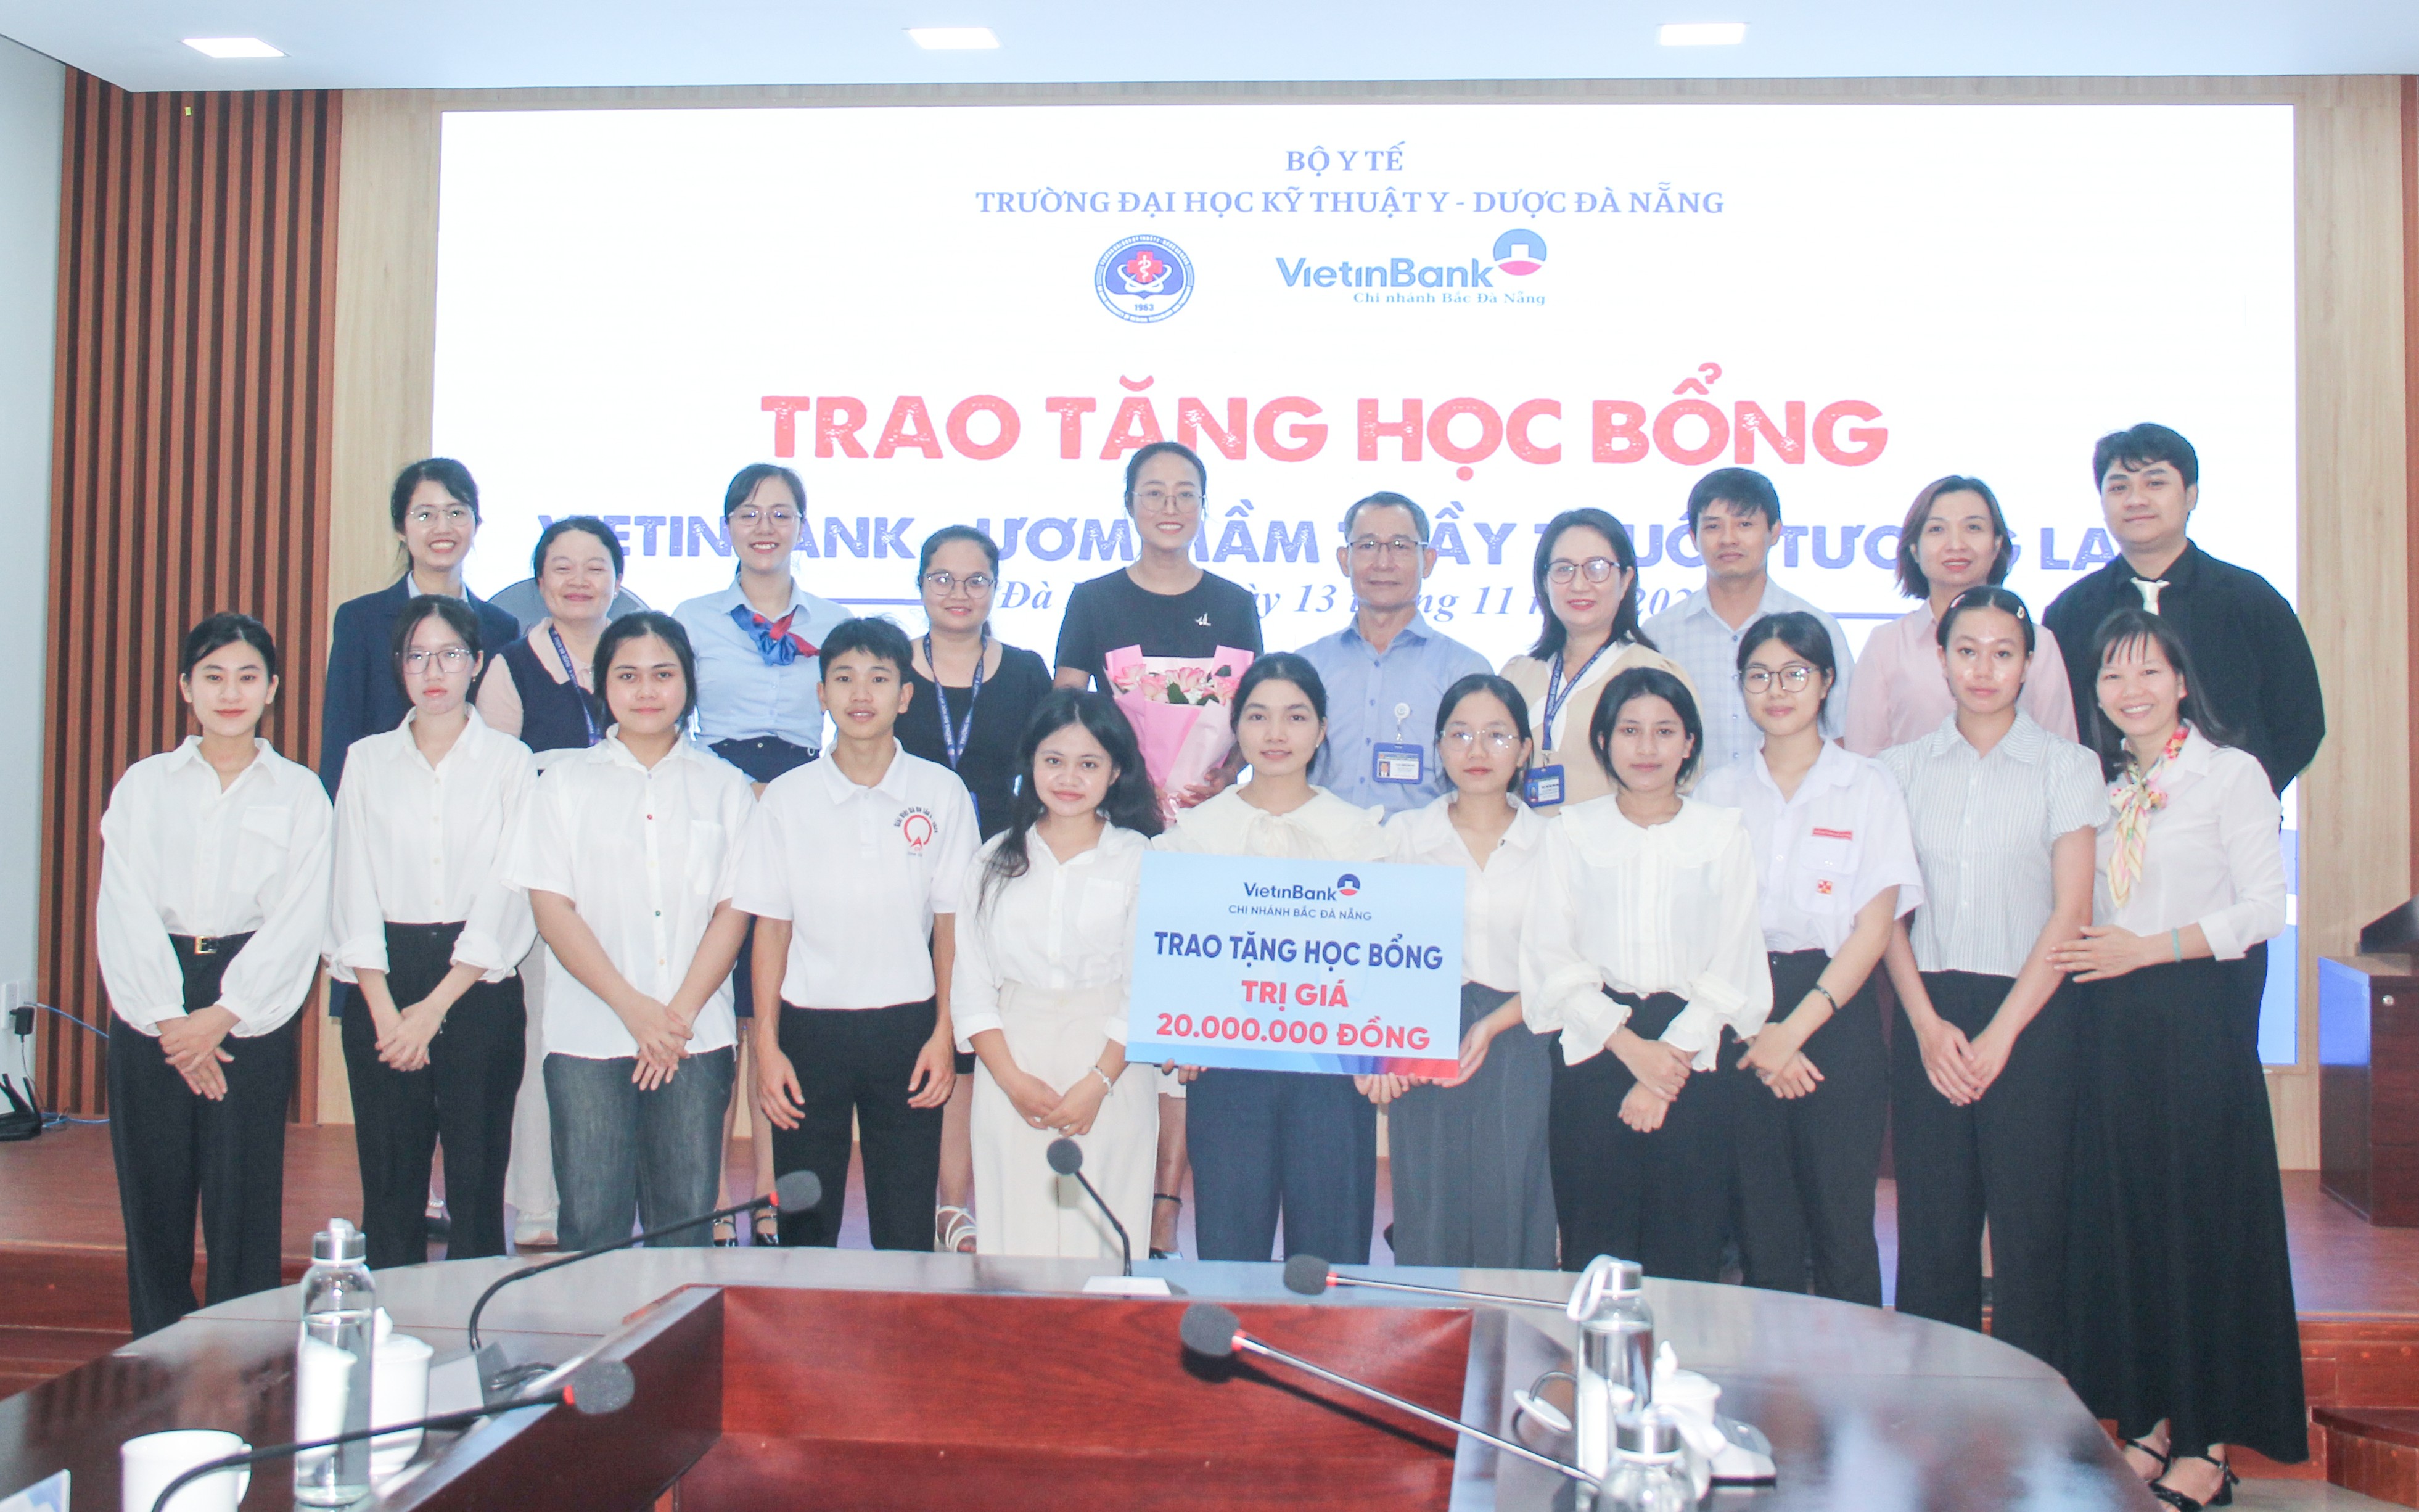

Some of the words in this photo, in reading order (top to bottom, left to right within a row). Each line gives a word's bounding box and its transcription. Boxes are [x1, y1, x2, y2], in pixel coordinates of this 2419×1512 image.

[1286, 144, 1330, 178] BỘ
[1337, 150, 1359, 171] Y
[1365, 141, 1406, 171] TẾ
[975, 186, 1110, 213] TRƯỜNG
[1118, 191, 1175, 218] ĐẠI
[1184, 191, 1254, 218] HỌC
[1262, 186, 1304, 213] KỸ
[1309, 186, 1423, 219] THUẬT
[1427, 191, 1450, 213] Y
[1472, 188, 1566, 219] DƯỢC
[1574, 186, 1622, 213] ĐÀ
[1628, 181, 1725, 214] NẴNG
[1275, 257, 1495, 288] VietinBank
[1134, 303, 1155, 311] 1963
[1353, 292, 1380, 303] Chi
[1386, 292, 1436, 303] nhánh
[1477, 292, 1498, 303] Đà
[761, 395, 1021, 461] TRAO
[1357, 396, 1562, 482] HỌC
[1591, 361, 1889, 467] BỔNG
[997, 580, 1053, 609] Đà
[1294, 584, 1337, 612] 13
[1471, 586, 1513, 614] 11
[1243, 882, 1337, 902] VietinBank
[1228, 905, 1248, 915] CHI
[1251, 906, 1290, 917] NHÁNH
[1294, 905, 1316, 918] BẮC
[1320, 907, 1336, 919] ĐÀ
[1154, 931, 1222, 958] TRAO
[1229, 931, 1297, 968] TẶNG
[1304, 940, 1361, 972] HỌC
[1368, 933, 1444, 970] BỔNG
[1242, 980, 1286, 1011] TRỊ
[1295, 979, 1349, 1008] GIÁ
[1156, 1013, 1328, 1045] 20.000.000
[1337, 1016, 1431, 1050] ĐỒNG
